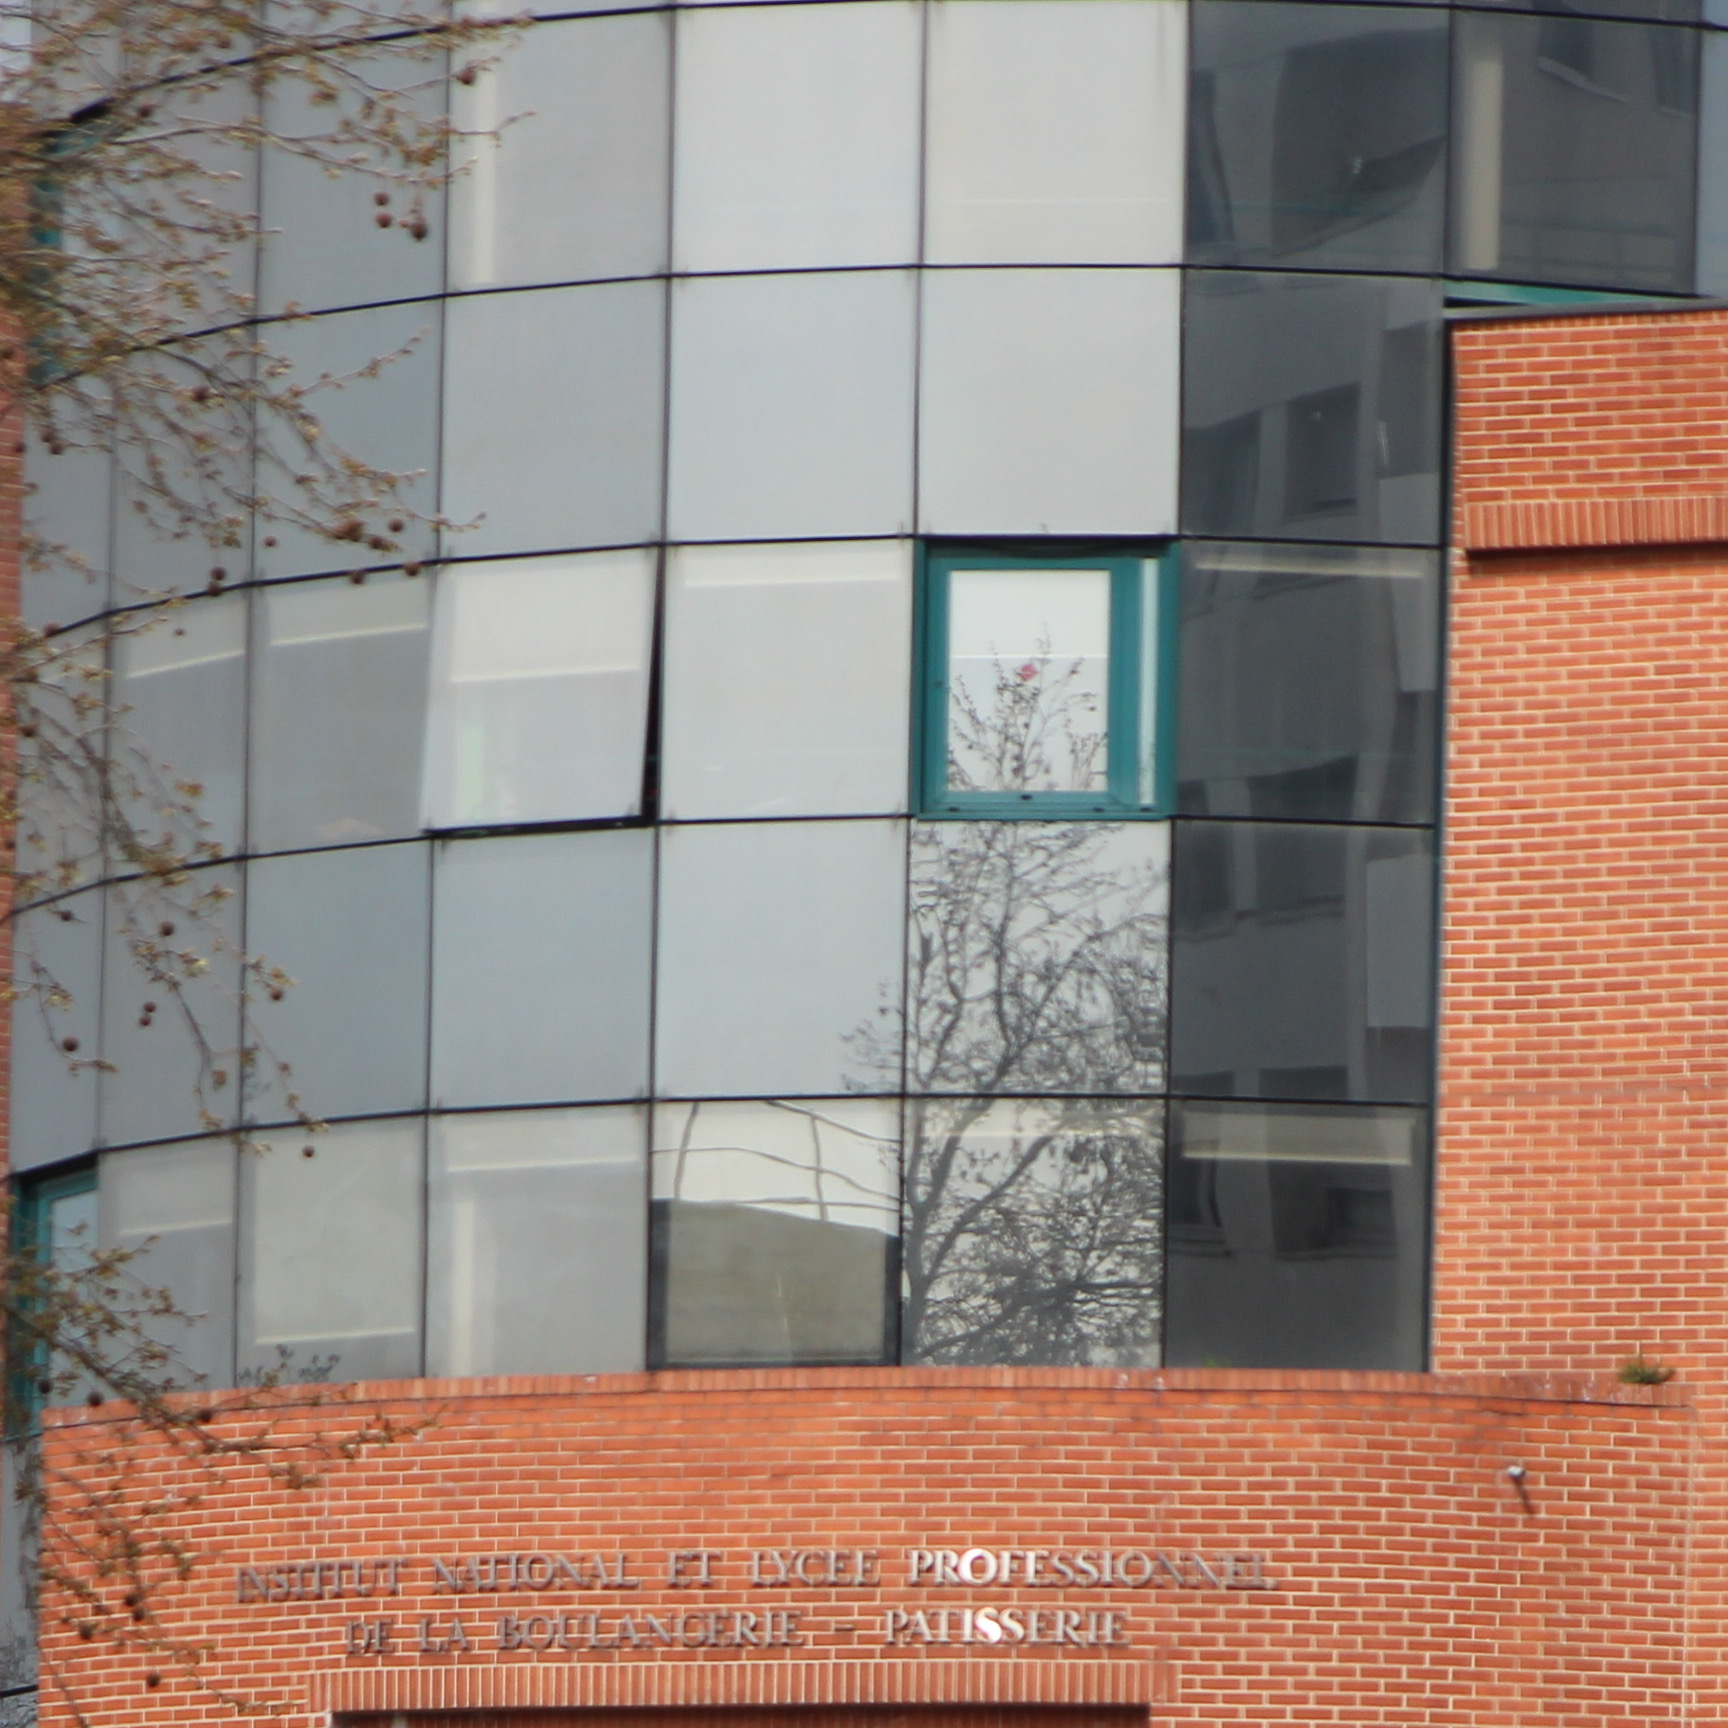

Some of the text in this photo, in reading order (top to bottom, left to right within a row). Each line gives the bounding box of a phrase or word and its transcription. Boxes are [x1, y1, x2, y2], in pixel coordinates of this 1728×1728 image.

[236, 1547, 1278, 1604] INSTITUT NATIONAL ET LYCEE PROFESSIONNEL
[345, 1617, 396, 1656] DE
[419, 1616, 472, 1654] LA
[497, 1609, 804, 1650] BOULANGERIE
[883, 1606, 1131, 1647] PATISSERIE
